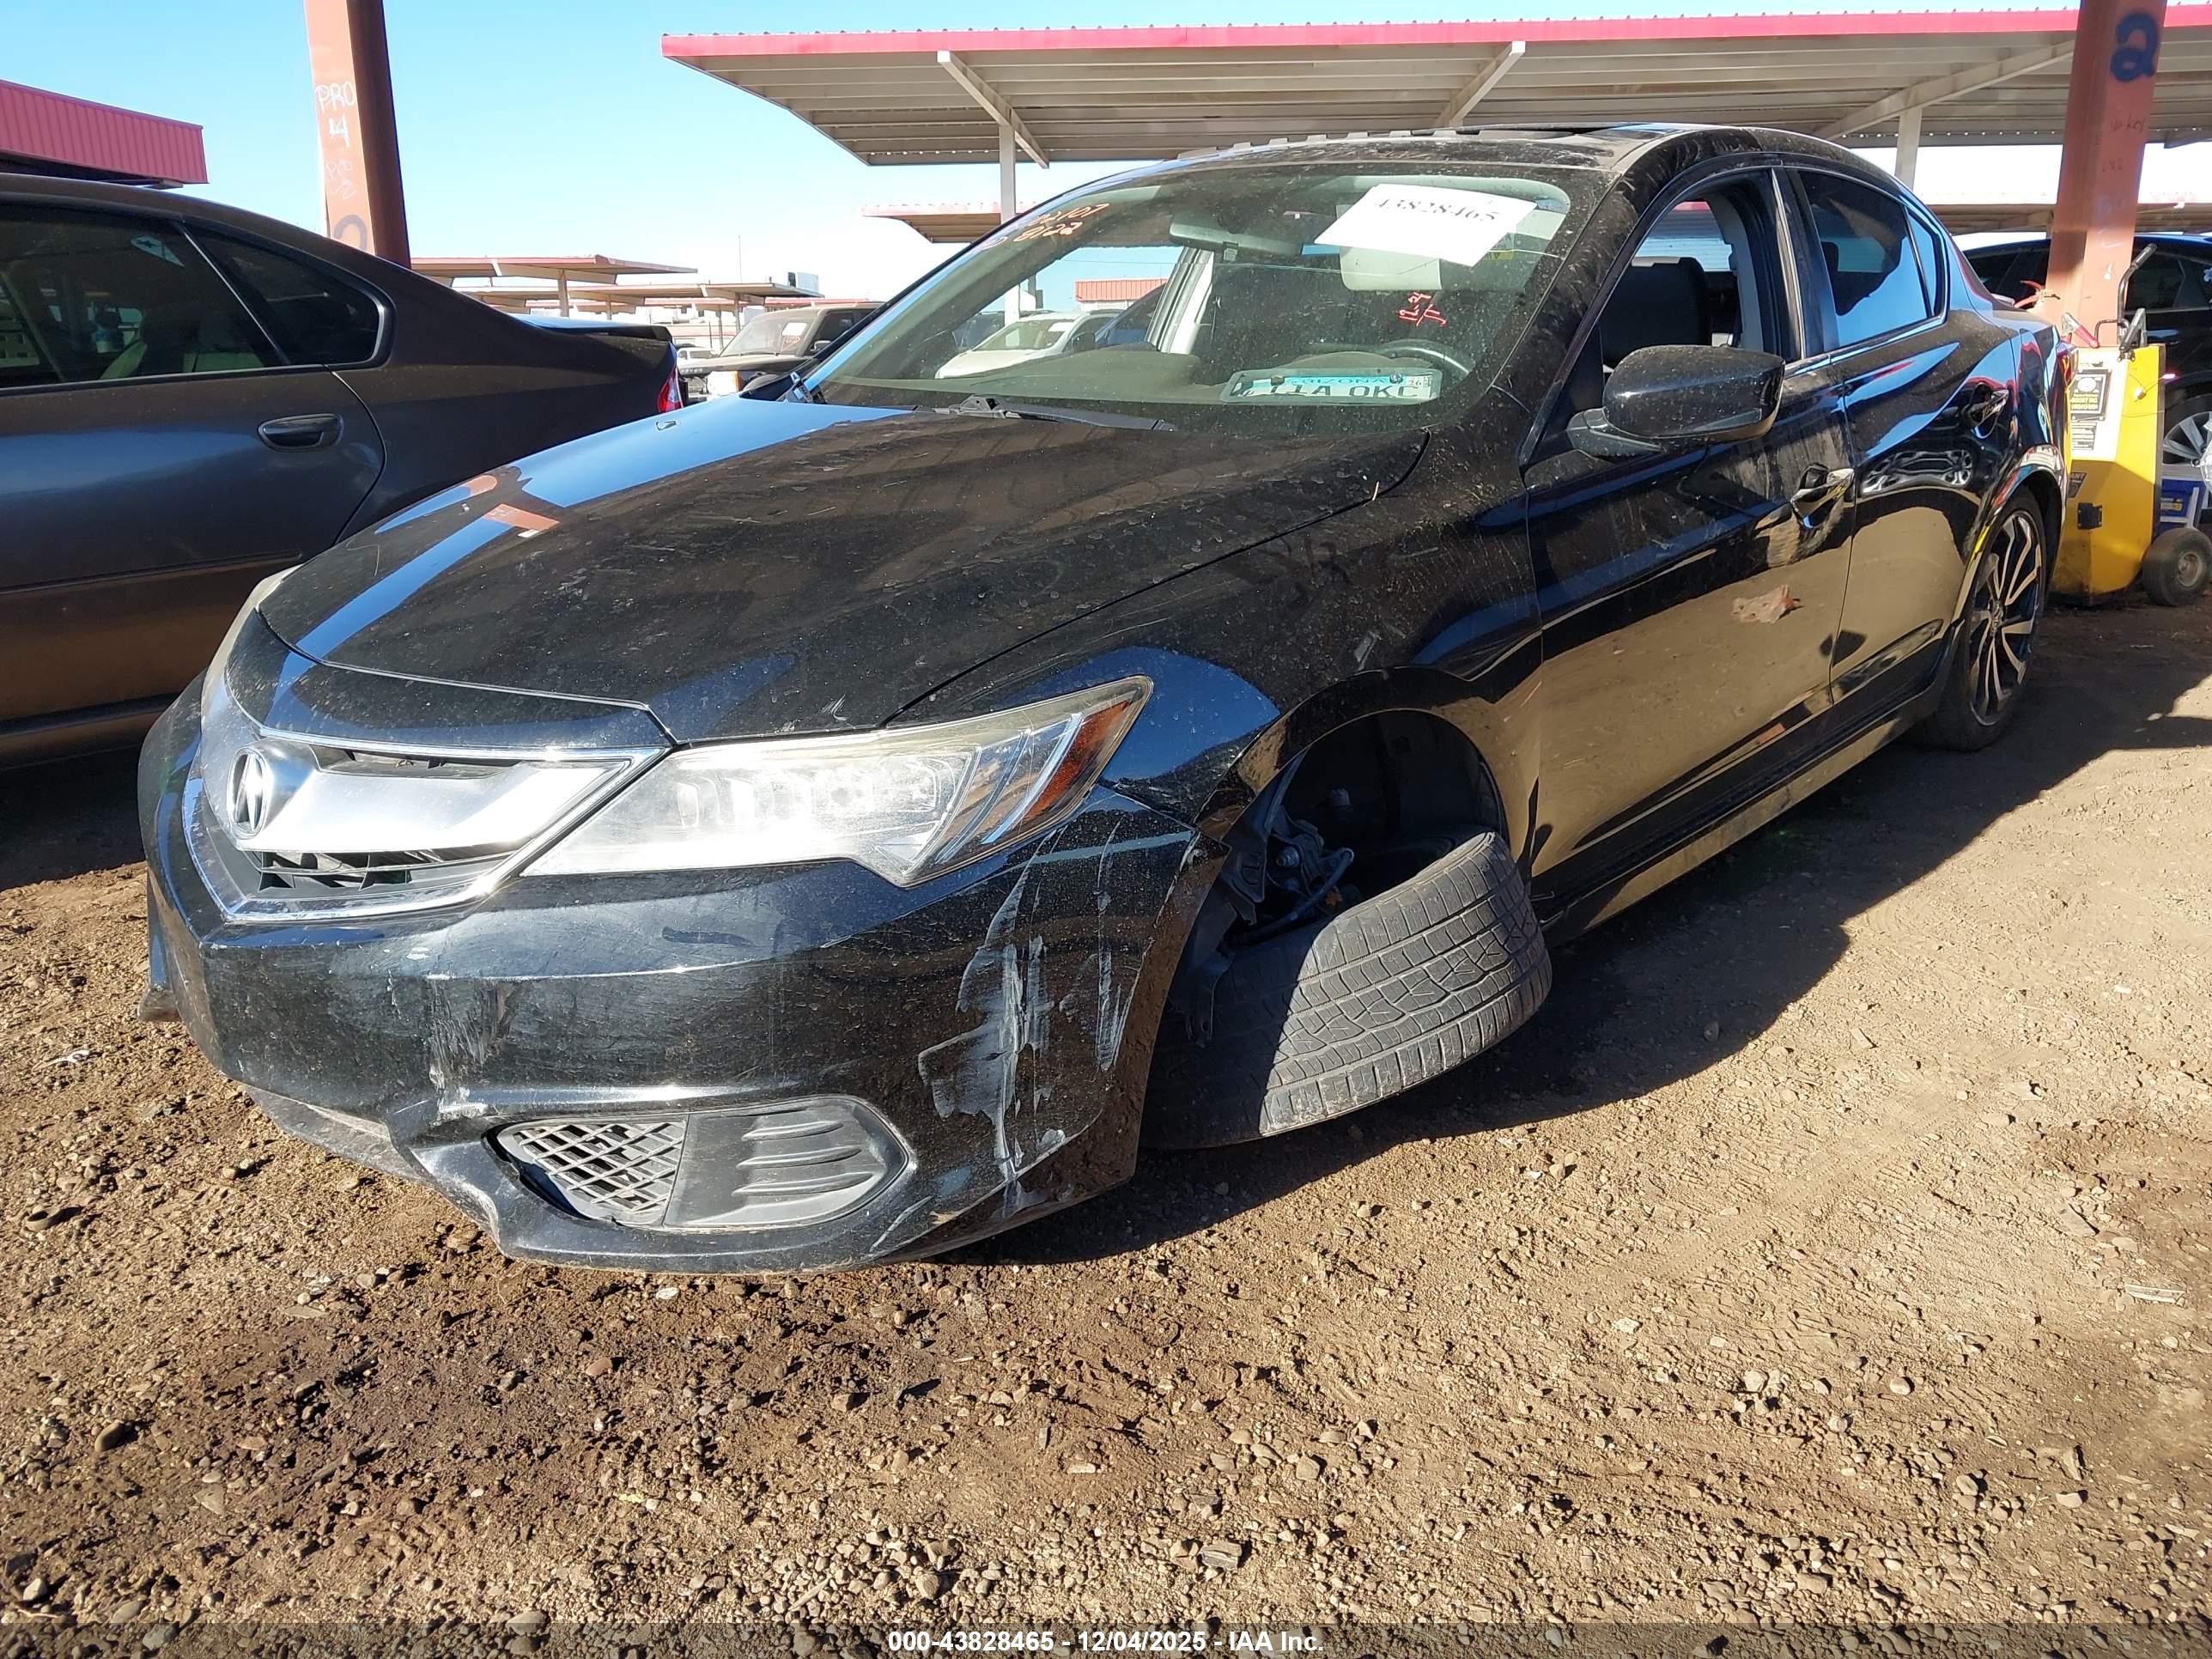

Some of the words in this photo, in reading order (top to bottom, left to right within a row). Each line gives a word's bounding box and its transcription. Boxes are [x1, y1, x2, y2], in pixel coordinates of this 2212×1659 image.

[2110, 12, 2160, 82] 2
[315, 82, 355, 113] PRO
[328, 113, 350, 148] 4
